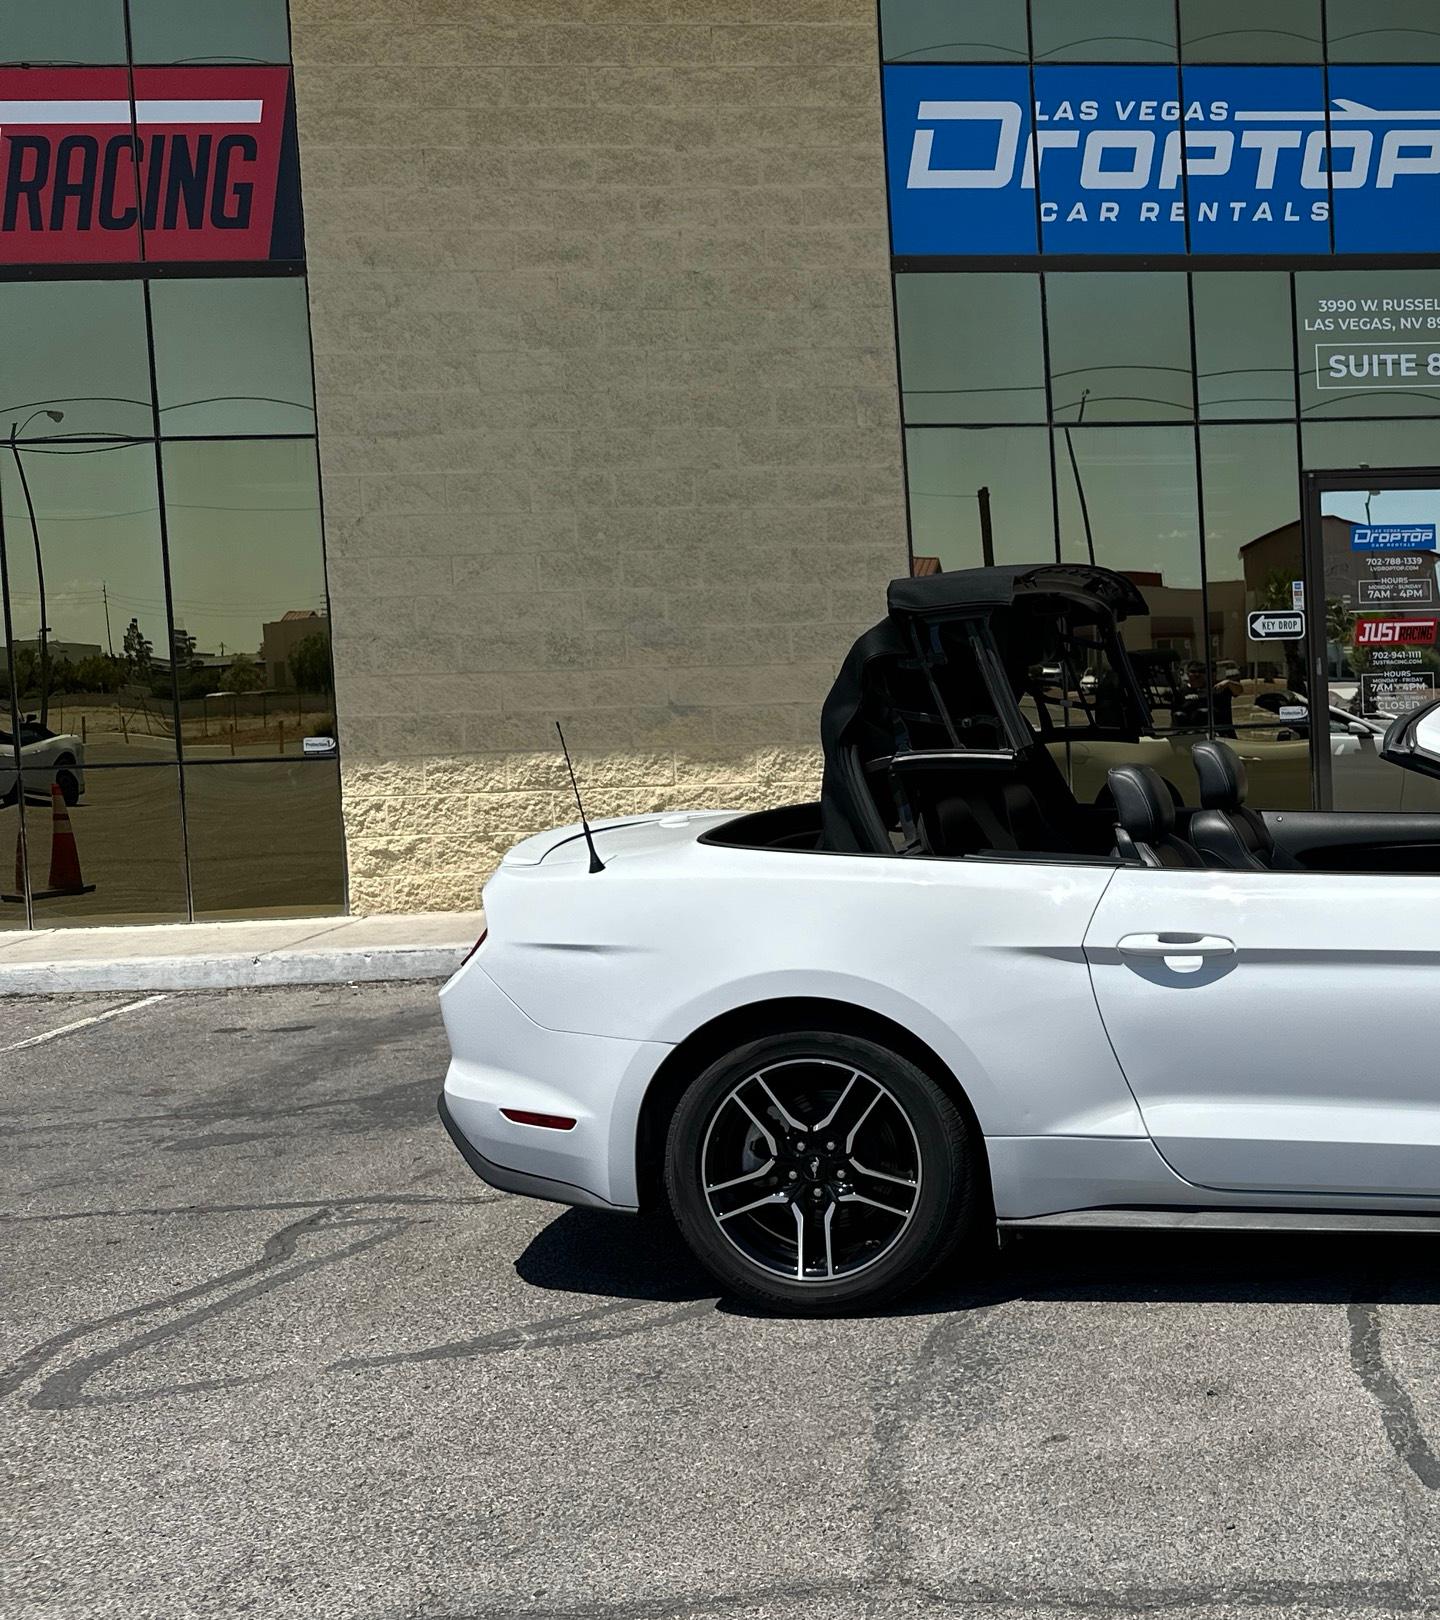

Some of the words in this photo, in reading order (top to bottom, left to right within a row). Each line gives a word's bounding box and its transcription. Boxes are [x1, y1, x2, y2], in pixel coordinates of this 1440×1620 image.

[1035, 101, 1099, 121] LAS
[1115, 100, 1230, 121] VEGAS
[2, 134, 258, 232] RACING
[1040, 202, 1119, 222] CAR
[1140, 201, 1331, 222] RENTALS
[1318, 300, 1357, 312] 3990
[1304, 318, 1335, 331] LAS
[1338, 317, 1396, 332] VEGAS,
[1400, 317, 1423, 329] NV
[1328, 353, 1418, 378] SUITE
[1366, 557, 1423, 566] 702-788-1339
[1367, 590, 1390, 599] 7AM
[1400, 589, 1423, 598] 4PM
[1262, 621, 1275, 630] KEY
[1278, 620, 1298, 630] DROP
[1359, 622, 1400, 641] JUST
[1400, 626, 1432, 640] RACING
[1372, 651, 1422, 659] 702-941-1111
[1370, 683, 1393, 692] 7AM
[1378, 701, 1420, 710] CLOSED
